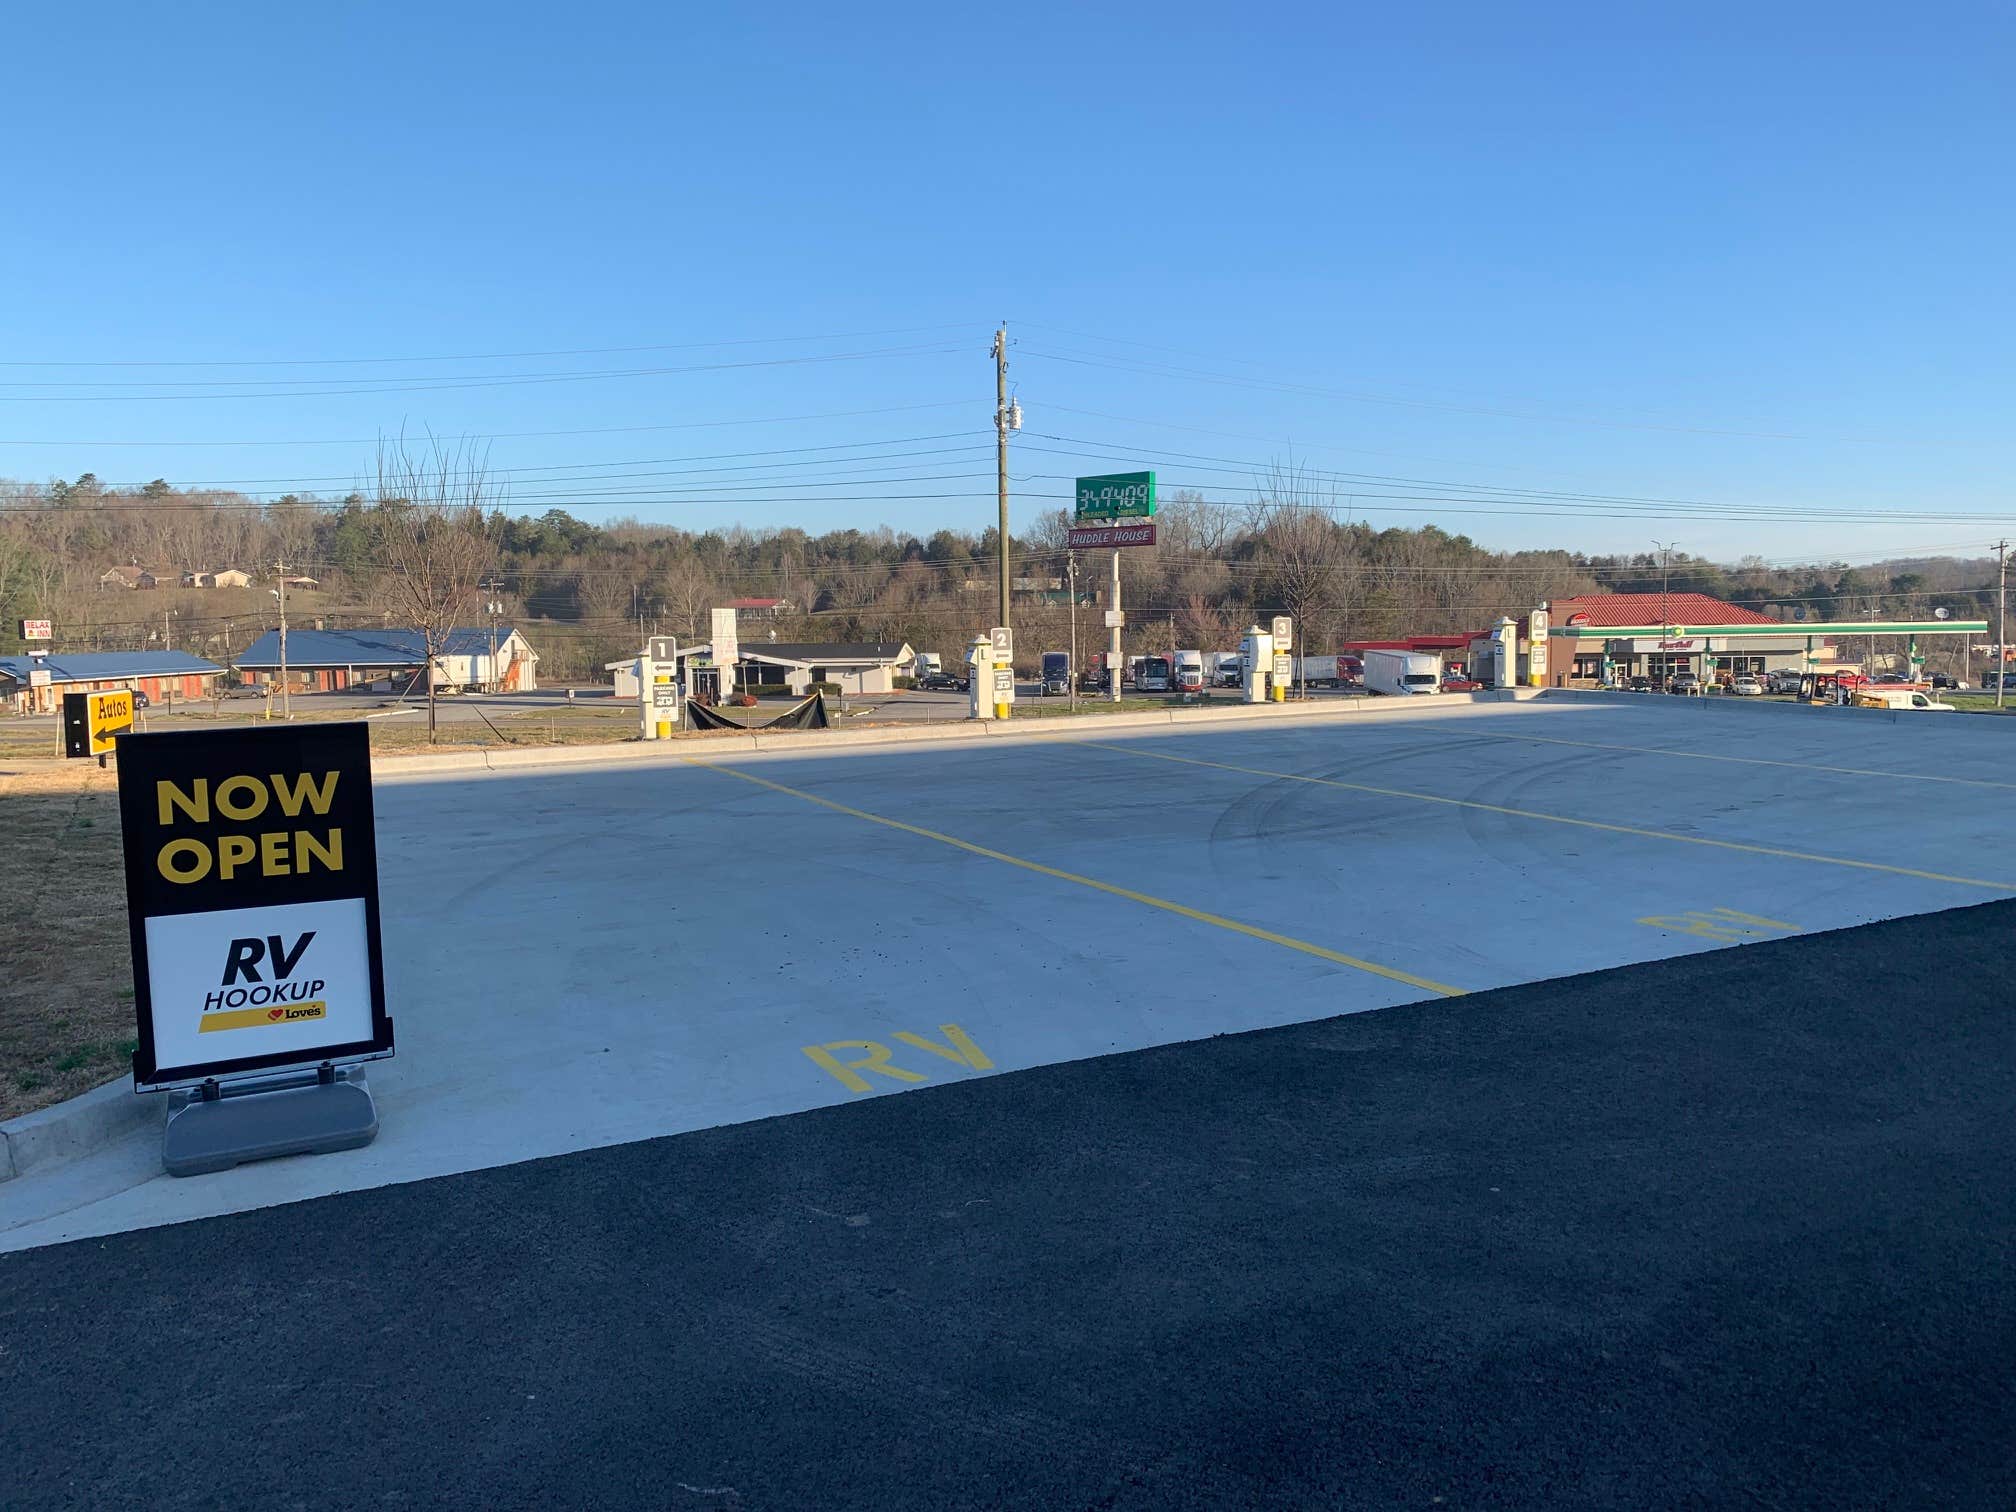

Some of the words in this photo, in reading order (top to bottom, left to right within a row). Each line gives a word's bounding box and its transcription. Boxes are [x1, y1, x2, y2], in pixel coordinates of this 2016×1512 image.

[1072, 533, 1110, 545] HUDDLE
[1114, 530, 1150, 542] HOUSE
[26, 620, 50, 629] RELAX
[1278, 622, 1287, 635] 3
[1535, 615, 1543, 626] 4
[37, 630, 50, 638] INN
[996, 633, 1007, 647] 2
[658, 642, 666, 658] 1
[98, 697, 128, 720] Autos
[157, 771, 340, 825] NOW
[157, 828, 344, 884] OPEN
[221, 931, 317, 986] RV
[203, 980, 325, 1011] HOOKUP
[800, 1023, 995, 1093] RV
